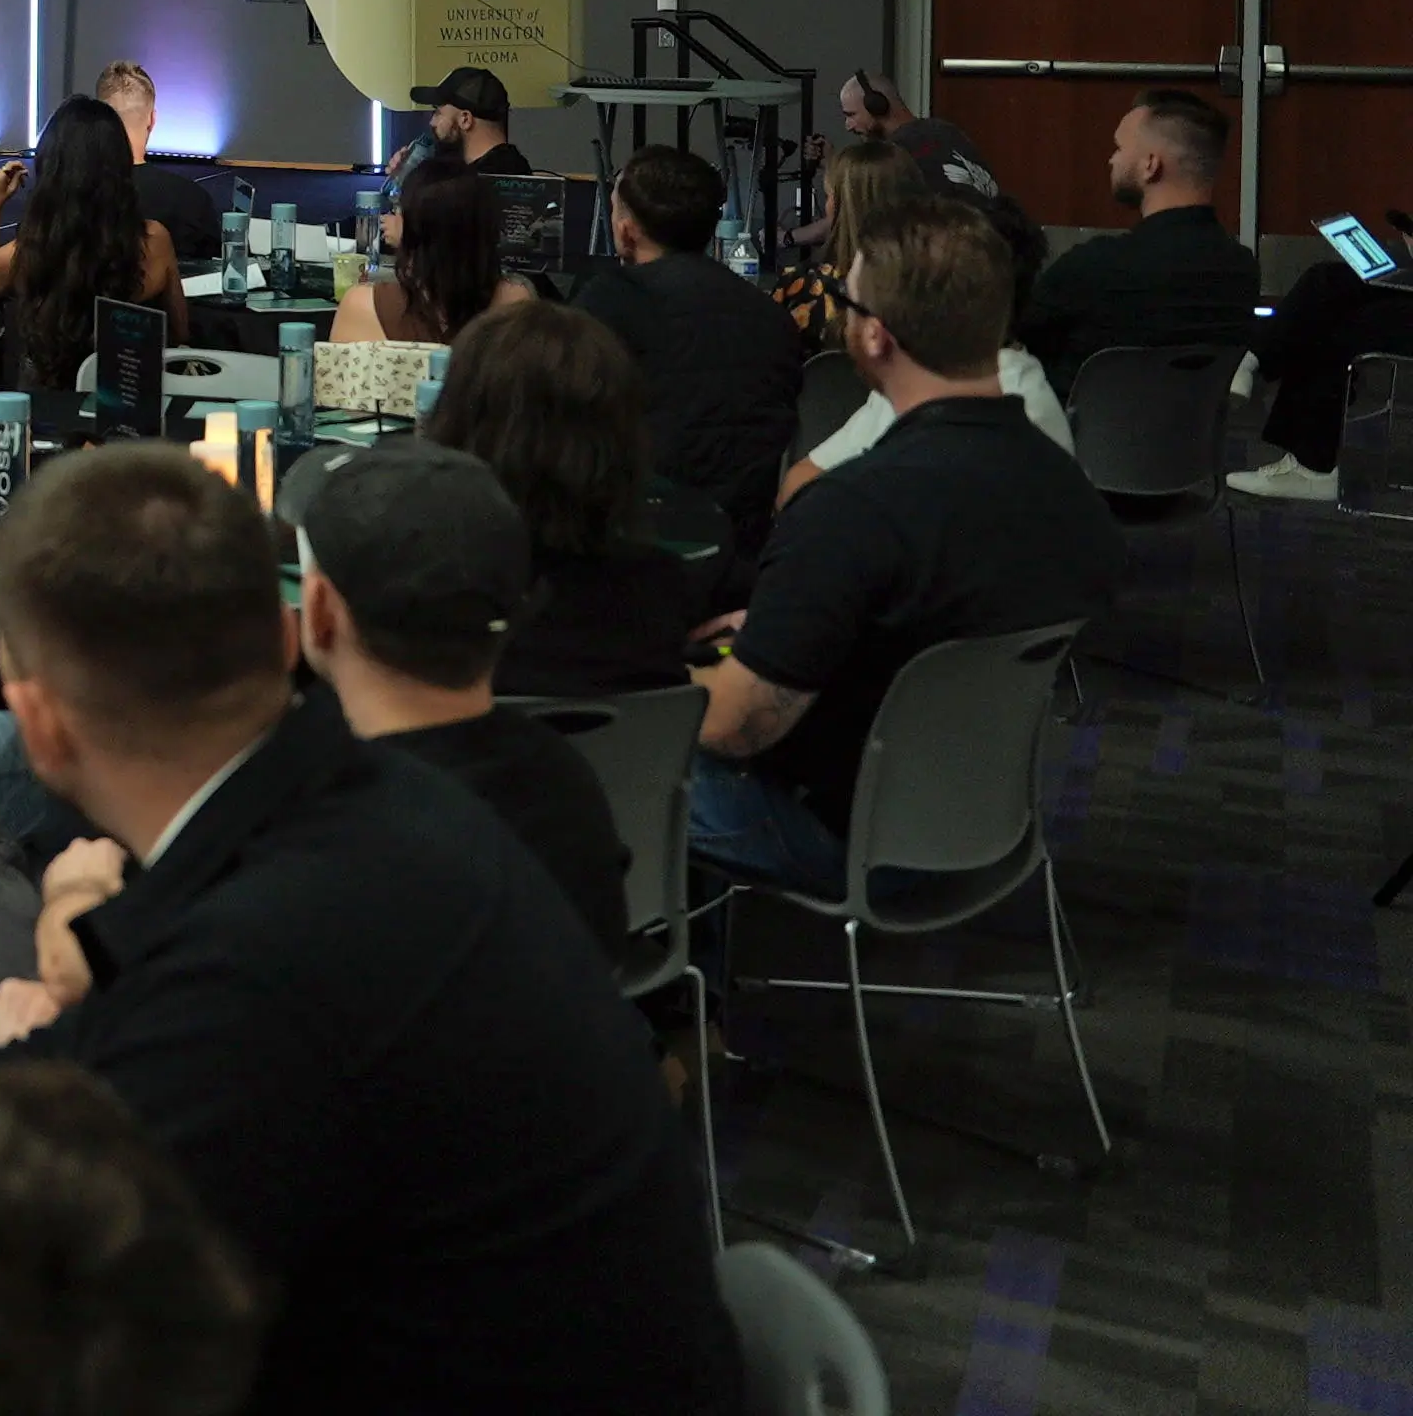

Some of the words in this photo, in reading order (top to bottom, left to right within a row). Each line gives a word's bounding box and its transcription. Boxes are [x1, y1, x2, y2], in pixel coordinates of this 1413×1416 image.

[447, 8, 524, 22] UNIVERSITY
[526, 8, 540, 21] of
[439, 26, 545, 41] WASHINGTON
[466, 51, 519, 64] TACOMA
